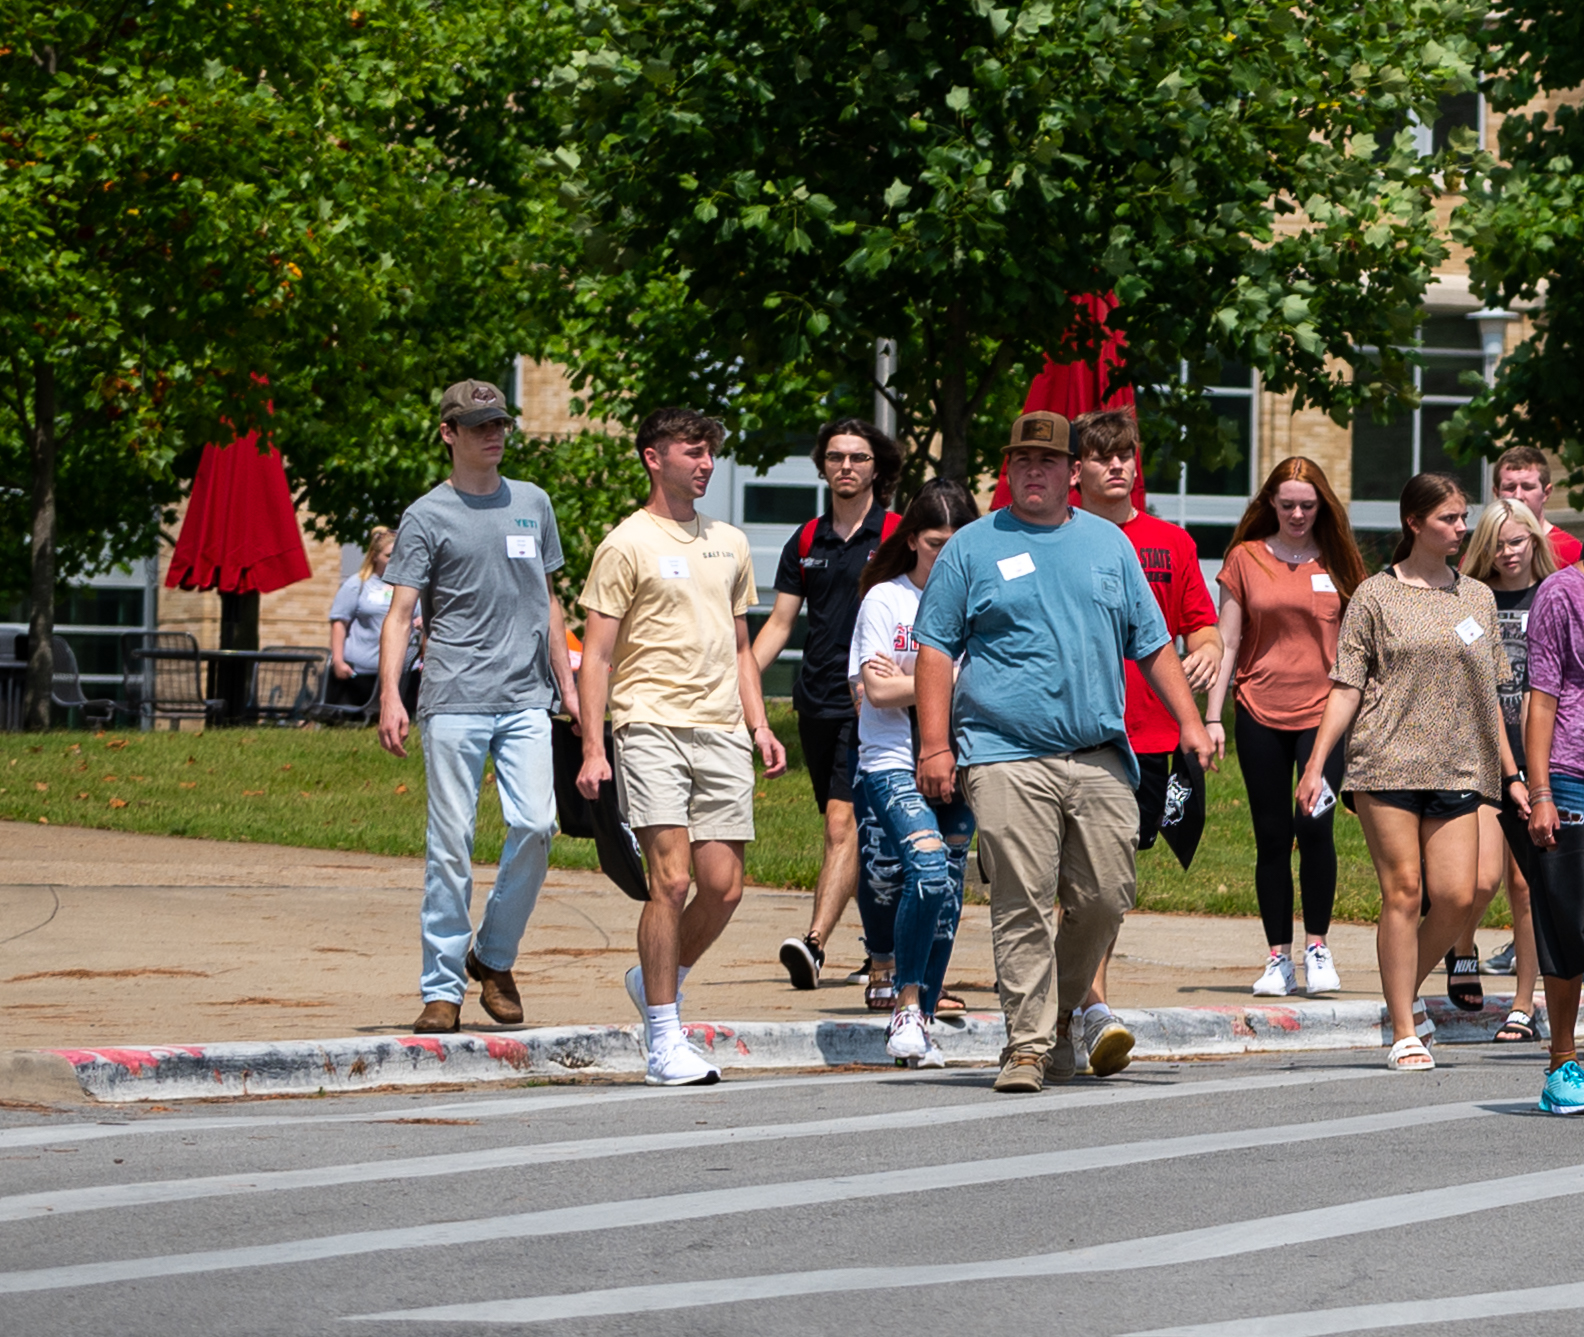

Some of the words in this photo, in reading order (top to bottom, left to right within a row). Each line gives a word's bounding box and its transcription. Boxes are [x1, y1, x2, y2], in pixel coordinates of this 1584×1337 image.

[515, 518, 538, 529] YETI
[1139, 547, 1171, 570] STATE
[1454, 959, 1477, 973] NIKE
